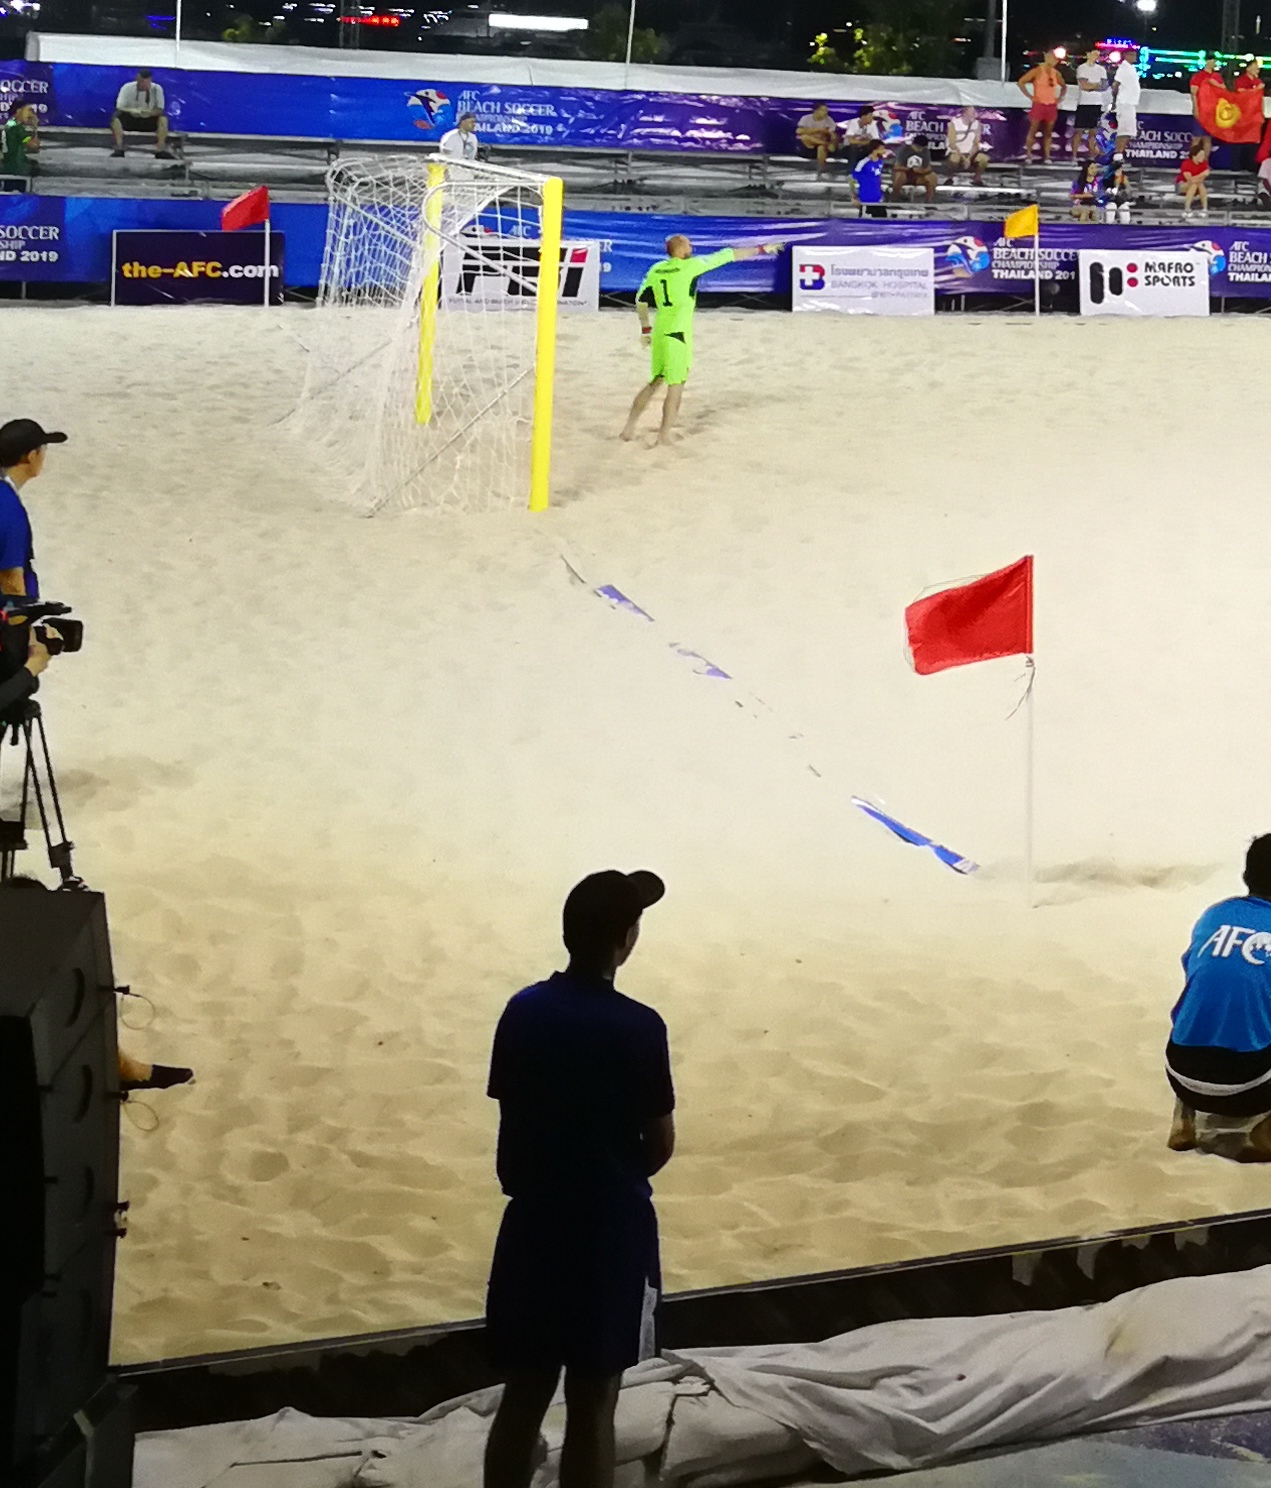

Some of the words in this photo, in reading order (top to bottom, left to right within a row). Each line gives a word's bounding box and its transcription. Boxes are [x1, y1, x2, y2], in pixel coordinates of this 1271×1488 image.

[0, 80, 50, 94] OCCER
[457, 100, 501, 114] BEACH
[504, 102, 558, 117] SOCCER
[905, 120, 945, 133] BEACH
[1164, 131, 1193, 143] SOCC
[1125, 149, 1178, 159] THAILAND
[20, 250, 59, 262] 2019
[1040, 249, 1078, 261] SOCCE
[1229, 251, 1268, 264] BEACH
[1055, 271, 1076, 280] 201
[1144, 275, 1196, 287] SPORTS
[659, 278, 673, 308] 1
